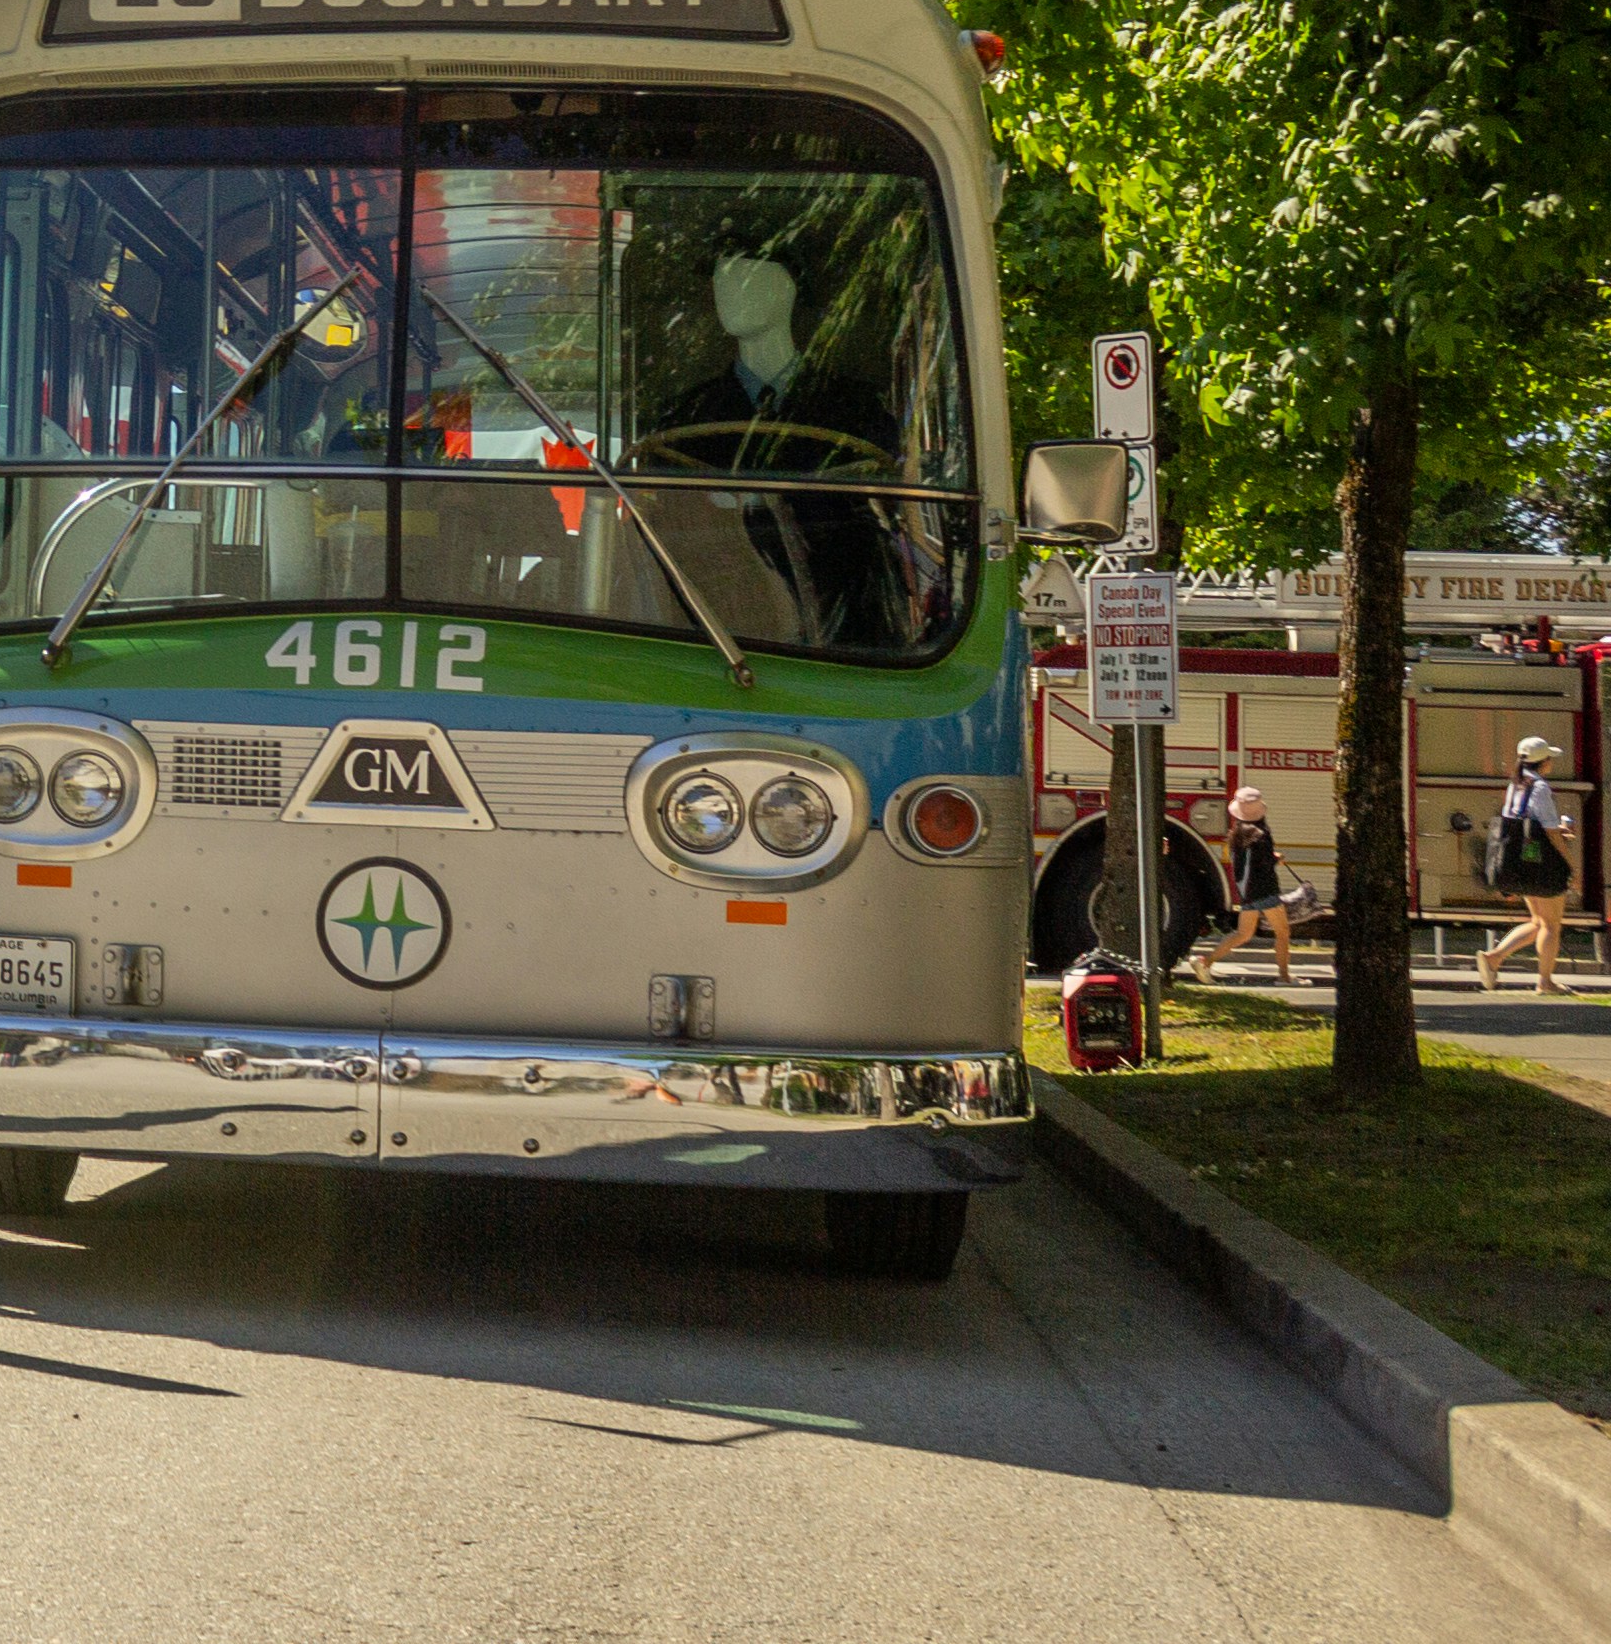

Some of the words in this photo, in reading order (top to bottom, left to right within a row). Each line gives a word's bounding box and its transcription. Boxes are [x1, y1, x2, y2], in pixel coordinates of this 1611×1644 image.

[1101, 585, 1140, 600] Canada
[1142, 584, 1162, 603] Day
[1441, 575, 1505, 601] FIRE
[1098, 603, 1135, 621] Special
[1138, 603, 1166, 618] Event
[1096, 626, 1111, 645] NO
[1114, 625, 1169, 646] STOPPING
[264, 619, 487, 692] 4612
[1099, 653, 1116, 666] July
[1100, 669, 1119, 683] July
[1123, 669, 1129, 681] 2
[1105, 689, 1120, 700] TOW
[1124, 689, 1143, 700] AWAY
[1145, 689, 1164, 700] ZONE
[1251, 751, 1335, 769] FIRE-RE
[343, 748, 431, 794] GM
[0, 958, 63, 988] 8645
